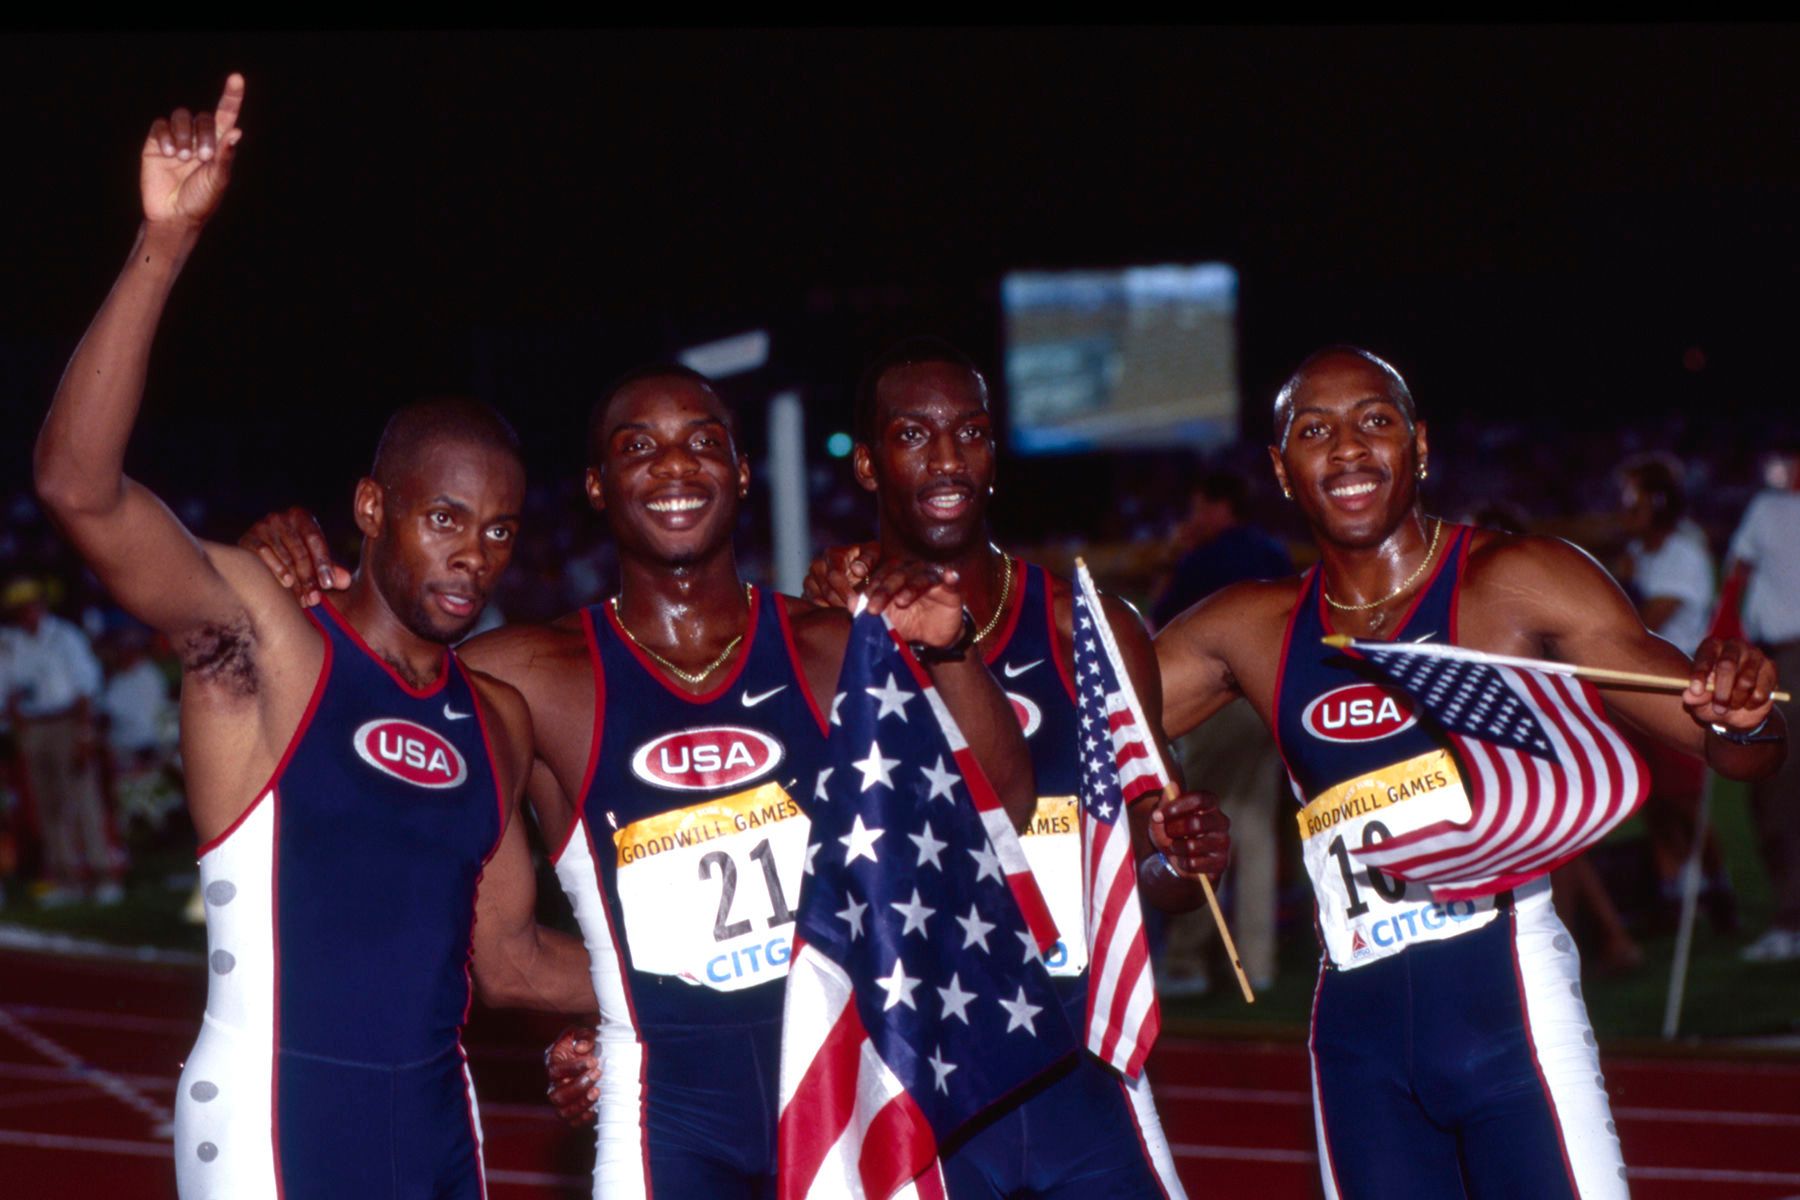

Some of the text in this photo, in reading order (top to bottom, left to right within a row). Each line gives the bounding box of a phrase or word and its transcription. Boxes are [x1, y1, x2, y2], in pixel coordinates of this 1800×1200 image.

[1322, 697, 1401, 728] USA
[380, 731, 451, 777] USA
[660, 741, 756, 774] USA
[1024, 816, 1070, 835] AMES
[1307, 793, 1382, 835] GOODWILL
[1387, 771, 1447, 803] GAMES
[622, 820, 727, 864] GOODWILL
[734, 800, 799, 831] GAMES
[698, 838, 797, 942] 21
[1371, 900, 1476, 947] CITGO
[706, 938, 791, 983] CITG
